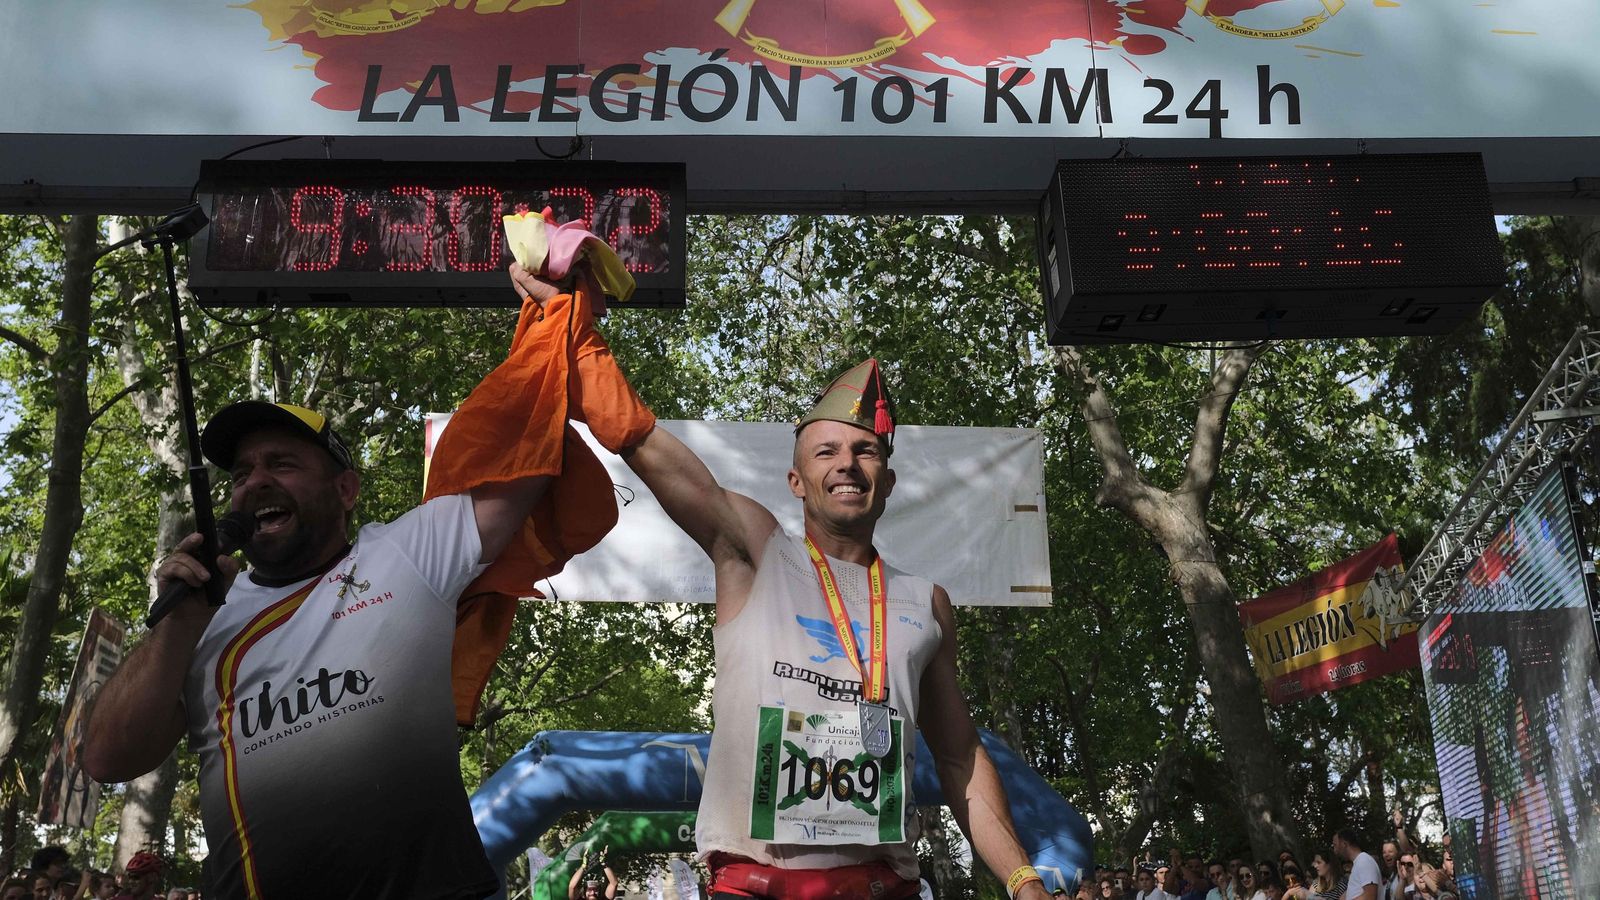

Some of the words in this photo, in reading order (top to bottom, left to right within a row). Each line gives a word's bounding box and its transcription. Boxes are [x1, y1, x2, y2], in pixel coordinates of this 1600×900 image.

[1225, 24, 1259, 37] BANDERA
[756, 44, 778, 58] TERCIO
[357, 64, 460, 122] LA
[489, 48, 802, 123] LEGIÓN
[833, 76, 953, 123] 101
[983, 67, 1113, 124] KM
[1142, 78, 1229, 138] 24
[1256, 64, 1301, 125] h
[331, 611, 346, 620] 101
[347, 600, 368, 614] KM
[370, 596, 384, 606] 24
[384, 591, 393, 600] H
[1263, 630, 1288, 665] LA
[1285, 599, 1357, 656] LEGIÓN
[239, 667, 375, 738] Chito
[243, 720, 312, 755] CONTANDO
[318, 695, 386, 724] HISTORIAS
[805, 736, 861, 746] Fundación
[828, 725, 860, 737] Unicaj
[781, 753, 880, 804] 1069
